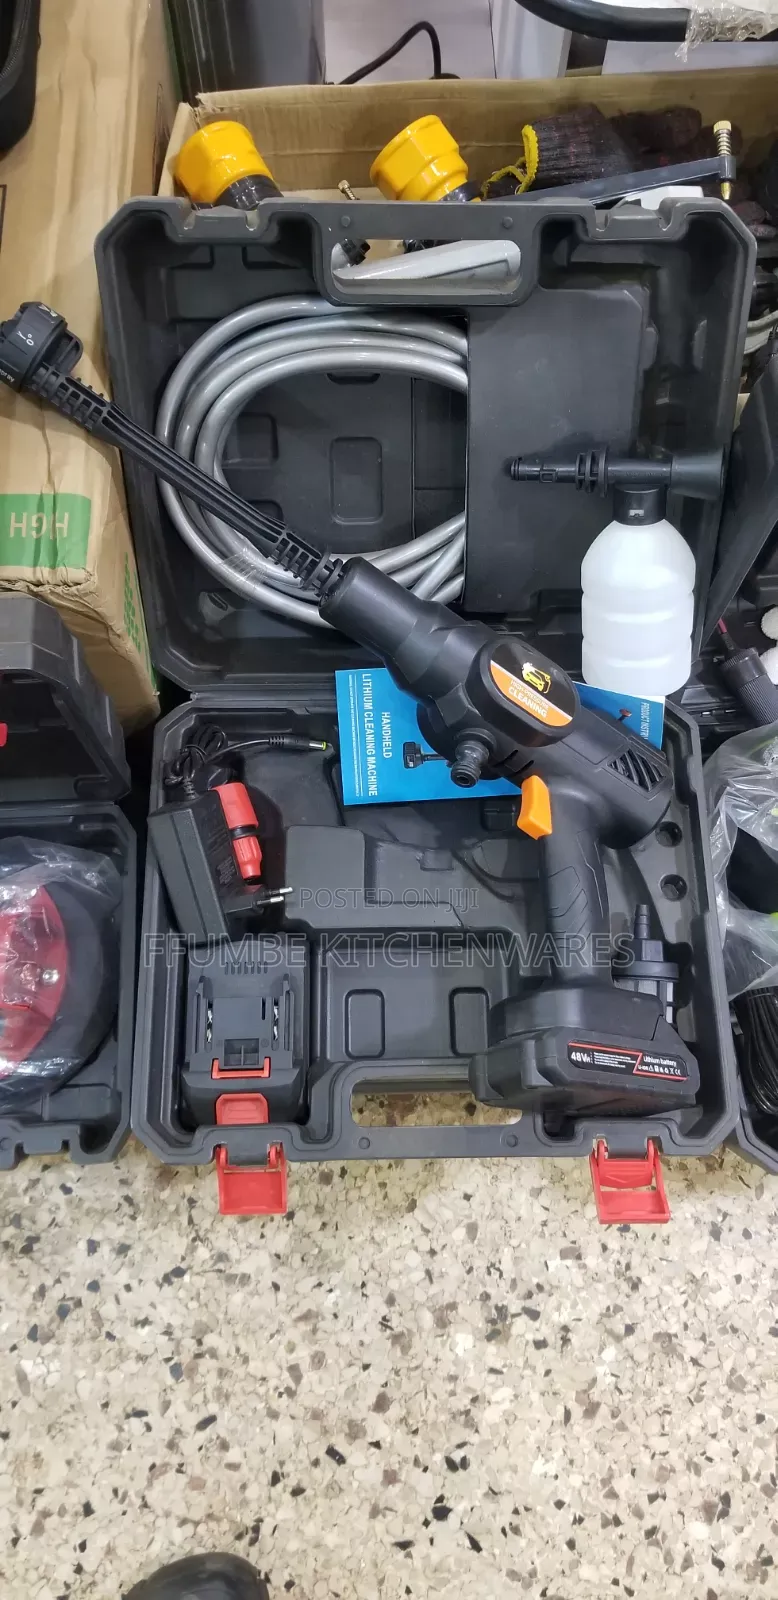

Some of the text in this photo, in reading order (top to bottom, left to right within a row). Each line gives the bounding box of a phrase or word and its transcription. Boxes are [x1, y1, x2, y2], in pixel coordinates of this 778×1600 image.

[508, 687, 547, 718] CLEANING
[362, 673, 378, 797] LITHIUM CLEANING MACHINE
[381, 711, 393, 759] HANDHELD
[643, 1055, 660, 1065] Lithium
[660, 1057, 677, 1068] battery
